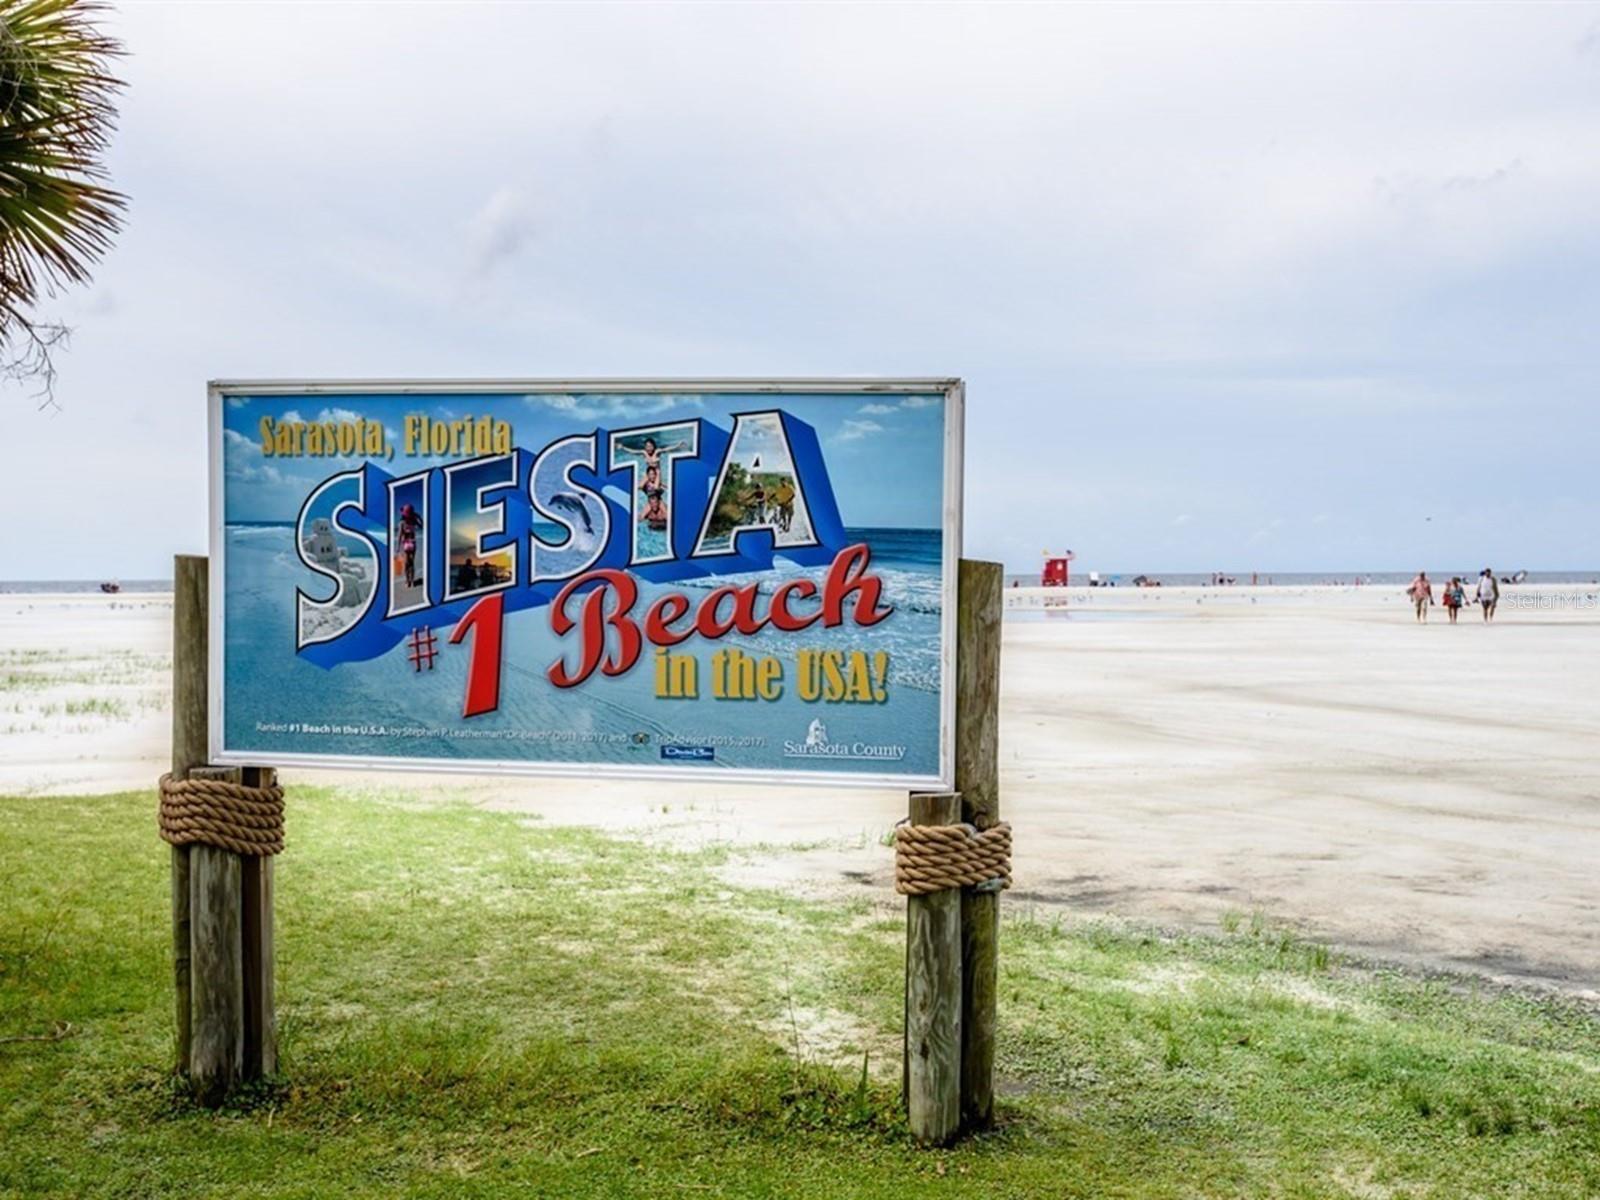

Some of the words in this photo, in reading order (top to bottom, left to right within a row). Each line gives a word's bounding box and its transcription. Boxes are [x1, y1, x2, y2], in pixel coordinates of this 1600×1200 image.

[259, 415, 395, 461] Sarasota,
[404, 414, 513, 457] Florida
[295, 409, 824, 656] SIESTA
[407, 592, 504, 719] #1
[547, 542, 893, 689] Beach
[655, 646, 698, 700] in
[712, 648, 784, 701] the
[797, 648, 889, 703] USA!
[302, 723, 331, 734] Beach
[784, 740, 848, 755] Sarasota
[853, 742, 906, 758] County
